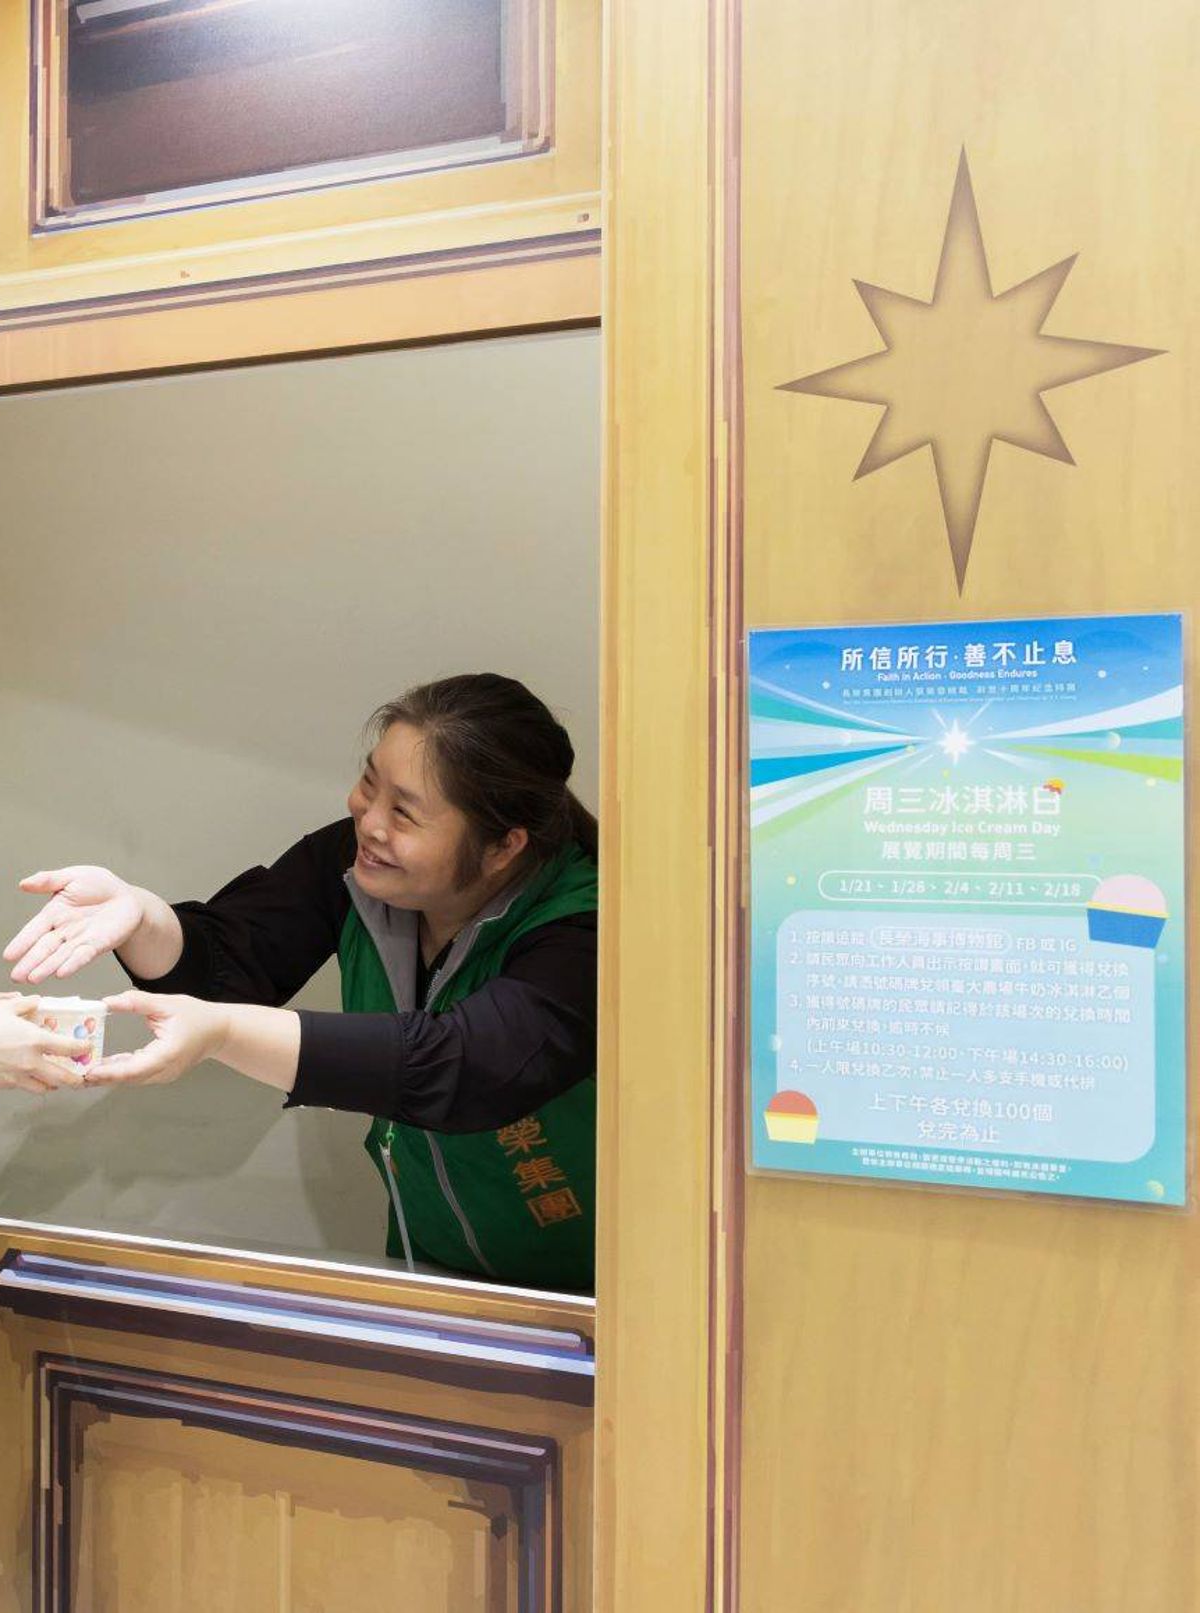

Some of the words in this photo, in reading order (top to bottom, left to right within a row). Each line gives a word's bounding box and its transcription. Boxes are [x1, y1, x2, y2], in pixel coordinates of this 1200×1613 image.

[877, 672, 900, 683] Faith
[913, 670, 941, 682] Action
[948, 669, 995, 681] Goodness
[997, 669, 1039, 680] Endures
[863, 785, 1062, 816] 周三冰淇淋日
[864, 821, 948, 837] Wednesday
[951, 821, 974, 834] Ice
[977, 821, 1028, 834] Cream
[1031, 821, 1062, 837] Day
[881, 840, 1037, 862] 展覽期間每周三
[916, 1120, 1002, 1144] 兌完為止
